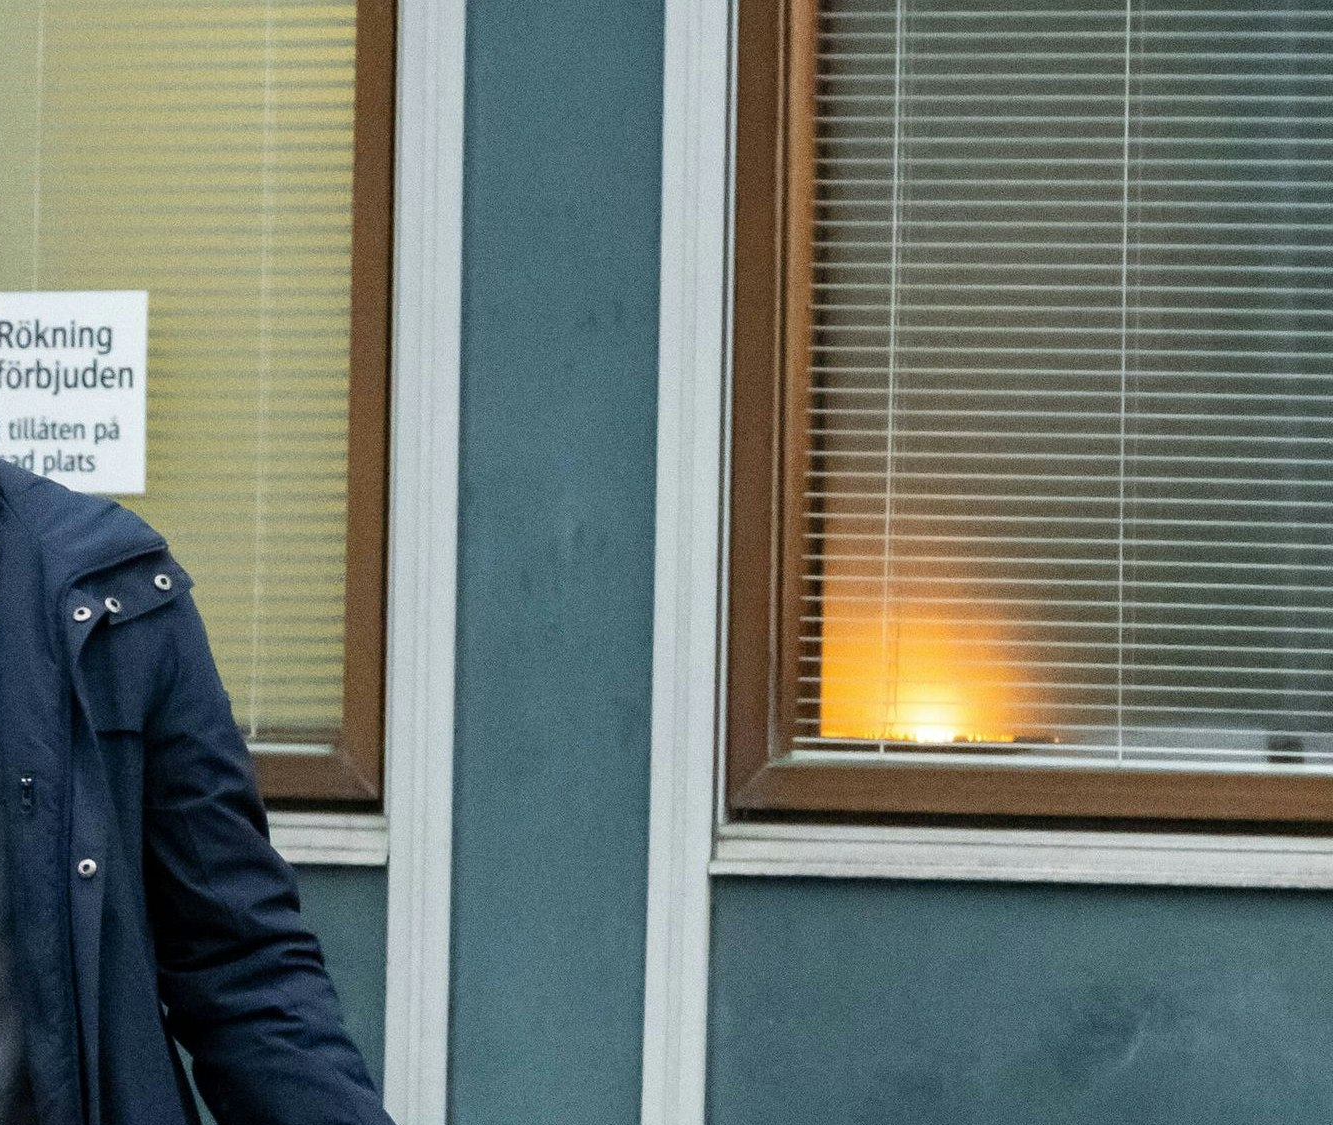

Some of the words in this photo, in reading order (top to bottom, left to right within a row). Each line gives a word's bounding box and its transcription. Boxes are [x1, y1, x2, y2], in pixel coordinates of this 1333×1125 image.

[9, 416, 85, 440] tillåten
[94, 415, 120, 444] på
[43, 451, 96, 476] plats
